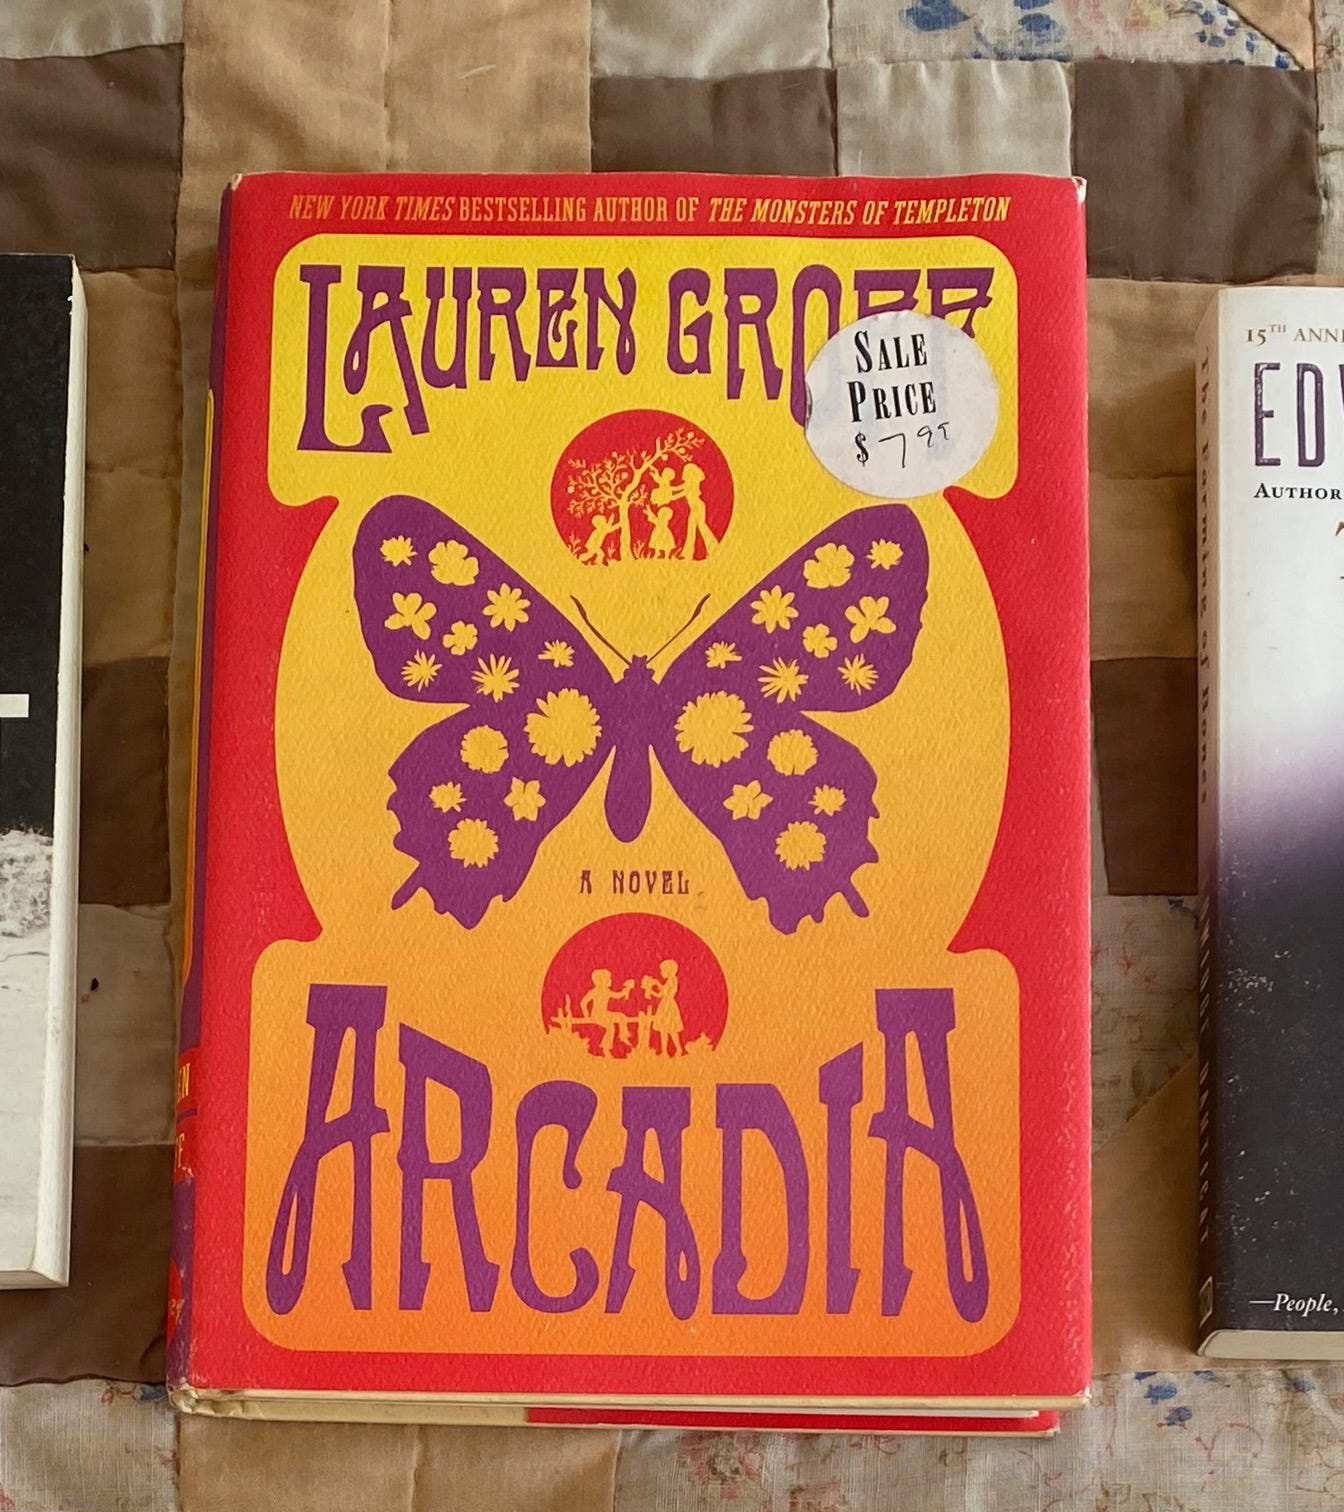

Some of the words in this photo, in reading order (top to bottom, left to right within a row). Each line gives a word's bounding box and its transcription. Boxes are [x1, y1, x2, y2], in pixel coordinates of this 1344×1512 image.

[288, 194, 334, 220] NEW
[340, 195, 388, 220] YORK
[394, 196, 456, 221] TIMES
[459, 196, 587, 222] BESTSELLING
[593, 197, 668, 222] AUTHOR
[676, 197, 700, 222] OF
[709, 198, 747, 222] THE
[750, 198, 858, 225] MONSTERS
[862, 200, 891, 225] OF
[893, 196, 1012, 225] TEMPLETON
[295, 263, 637, 453] LAUREN
[579, 869, 593, 895] A
[611, 869, 691, 896] NOVEL
[264, 983, 991, 1324] ARCADIA
